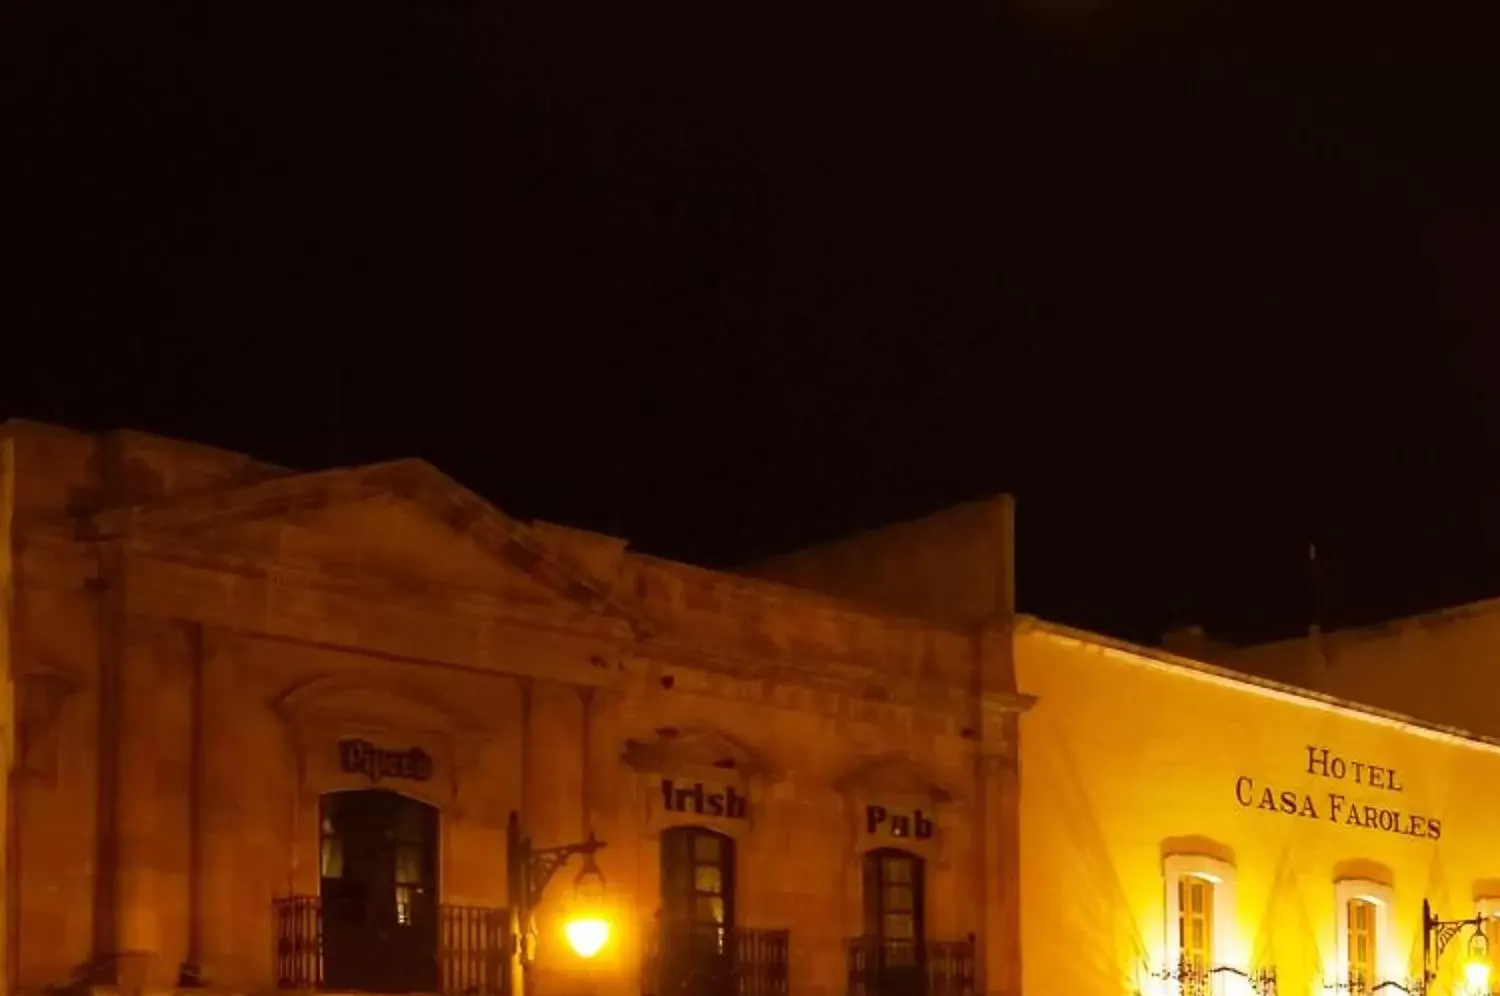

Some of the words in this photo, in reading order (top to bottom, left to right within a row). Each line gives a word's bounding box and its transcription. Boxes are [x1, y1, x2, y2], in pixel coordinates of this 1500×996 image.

[1307, 744, 1402, 791] HOTEL
[661, 779, 746, 819] Irish
[866, 805, 932, 839] Pub
[1235, 776, 1318, 818] CASA
[1328, 793, 1441, 840] FAROLES
